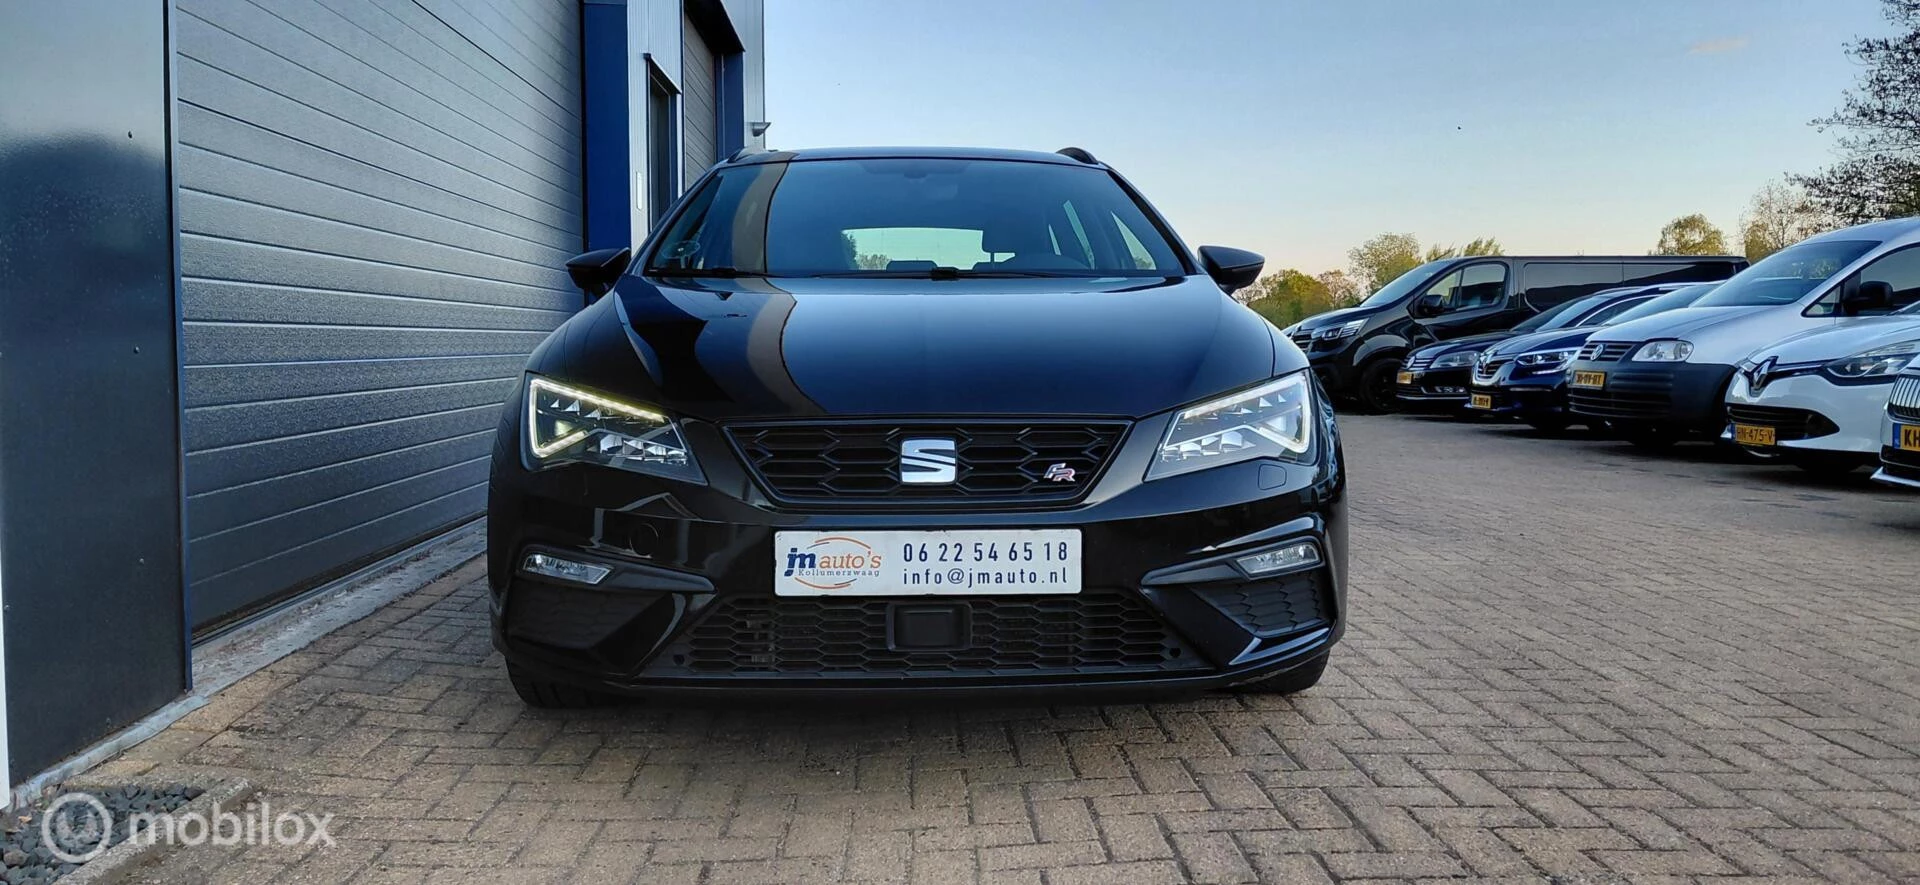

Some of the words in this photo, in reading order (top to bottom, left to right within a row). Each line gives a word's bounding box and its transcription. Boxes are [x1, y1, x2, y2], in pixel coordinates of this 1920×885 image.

[1043, 463, 1076, 481] FR
[903, 543, 928, 562] 06
[938, 543, 963, 561] 22
[973, 543, 998, 561] 54
[1008, 542, 1033, 561] 65
[1044, 541, 1067, 561] 18
[903, 567, 1067, 588] info@jmauto.nl
